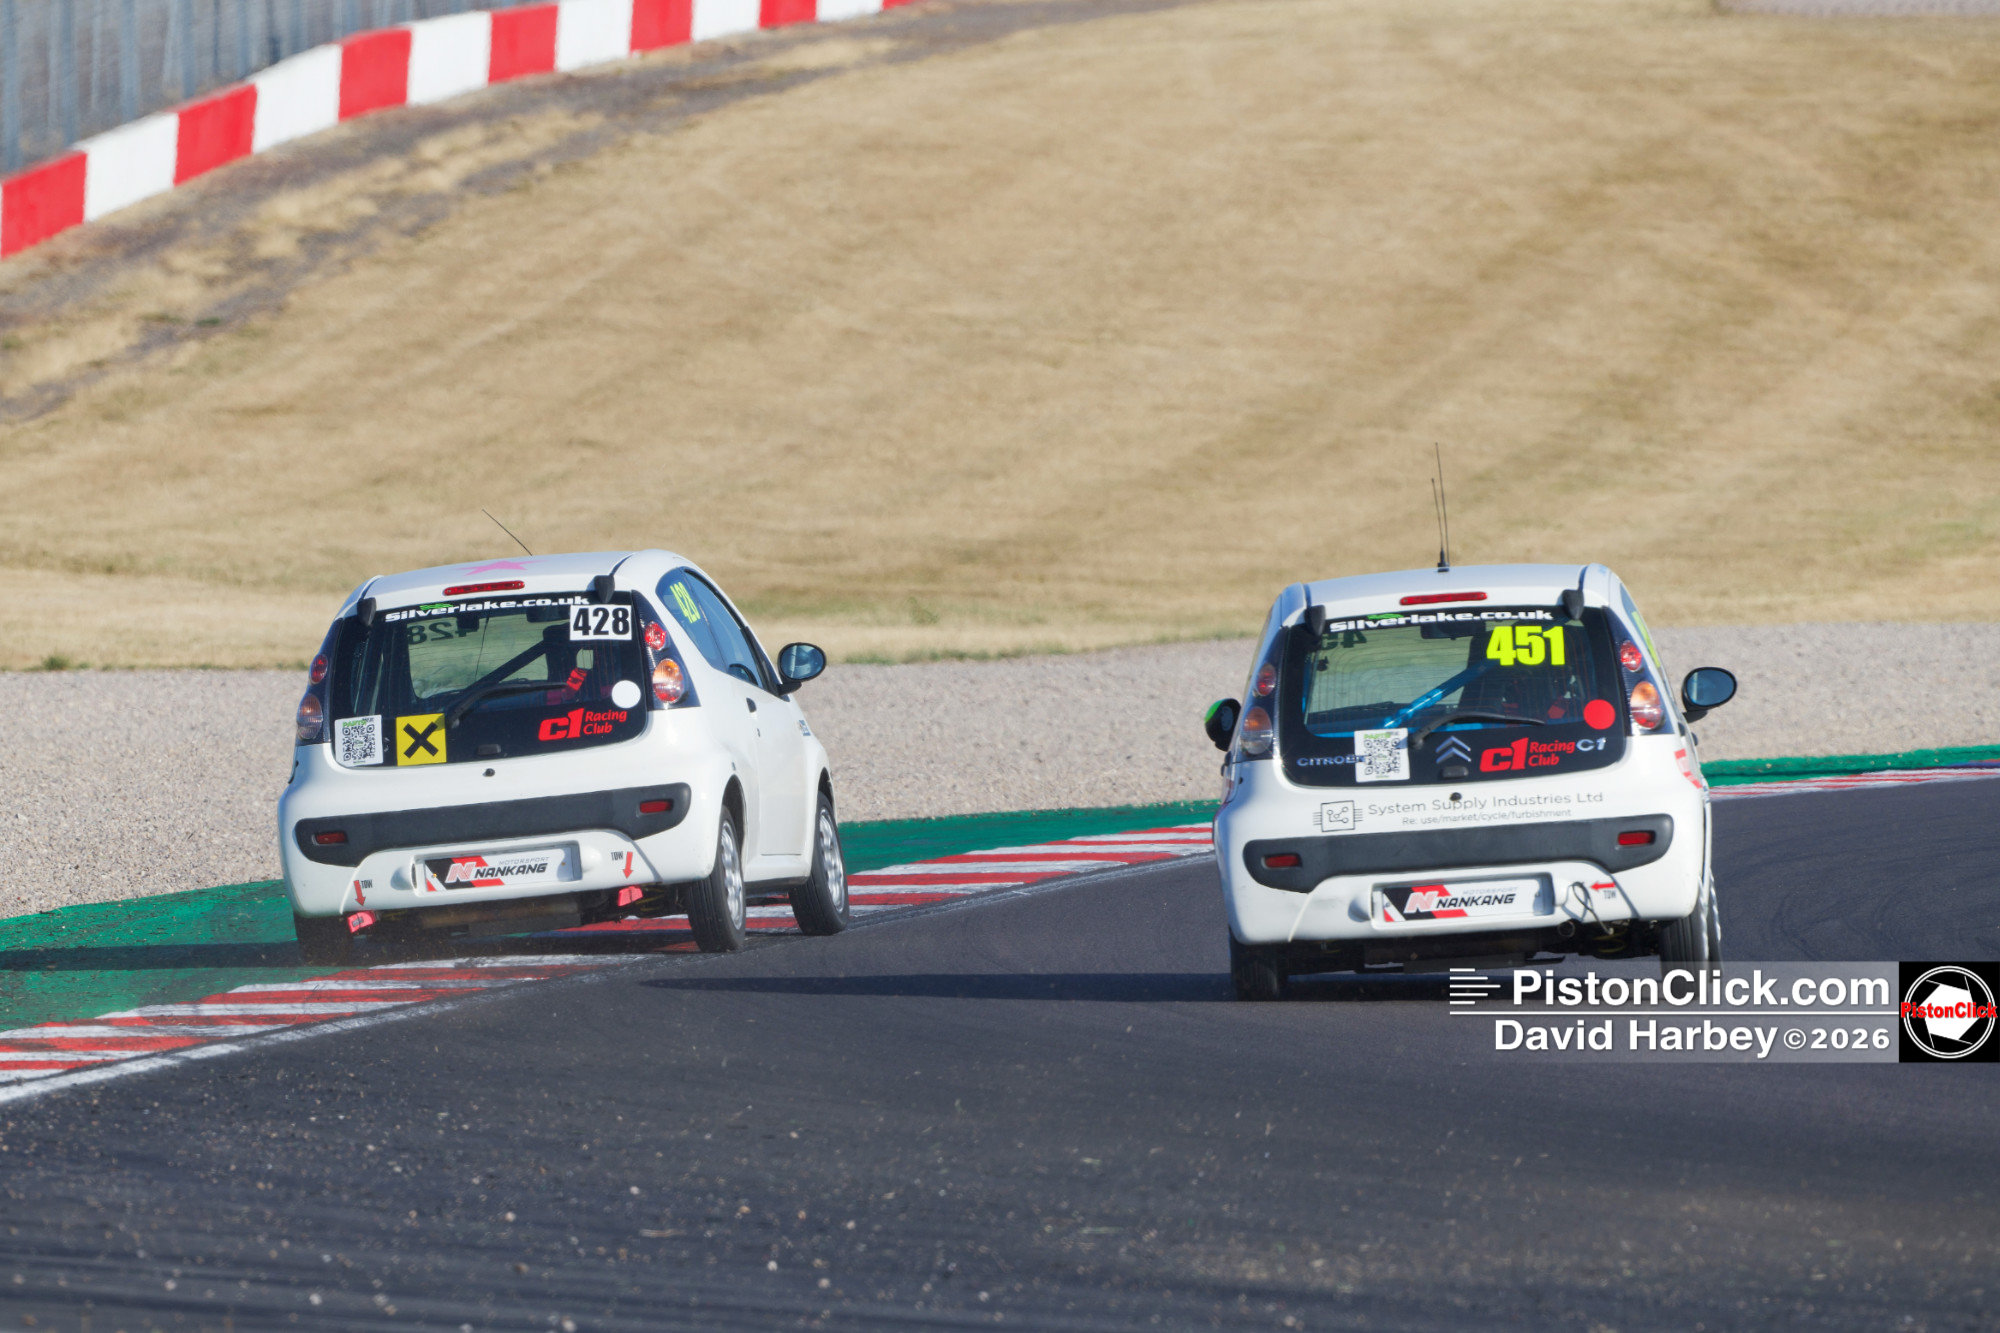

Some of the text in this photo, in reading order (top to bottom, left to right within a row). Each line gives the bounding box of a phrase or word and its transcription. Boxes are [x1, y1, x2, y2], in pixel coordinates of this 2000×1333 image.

[385, 596, 590, 623] Silverlake.co.uk
[573, 607, 630, 636] 428
[1329, 610, 1553, 633] Silverlake.co.uk
[1486, 625, 1566, 666] 451
[585, 709, 628, 722] Racing
[583, 721, 613, 735] Club
[1529, 740, 1576, 754] Racing
[1576, 737, 1606, 751] C1
[1527, 753, 1560, 767] Club
[1368, 792, 1604, 816] System Supply Industries Ltd
[499, 856, 551, 866] MOTORSPORT
[474, 863, 549, 879] NANKANG
[1436, 893, 1517, 909] NANKANG
